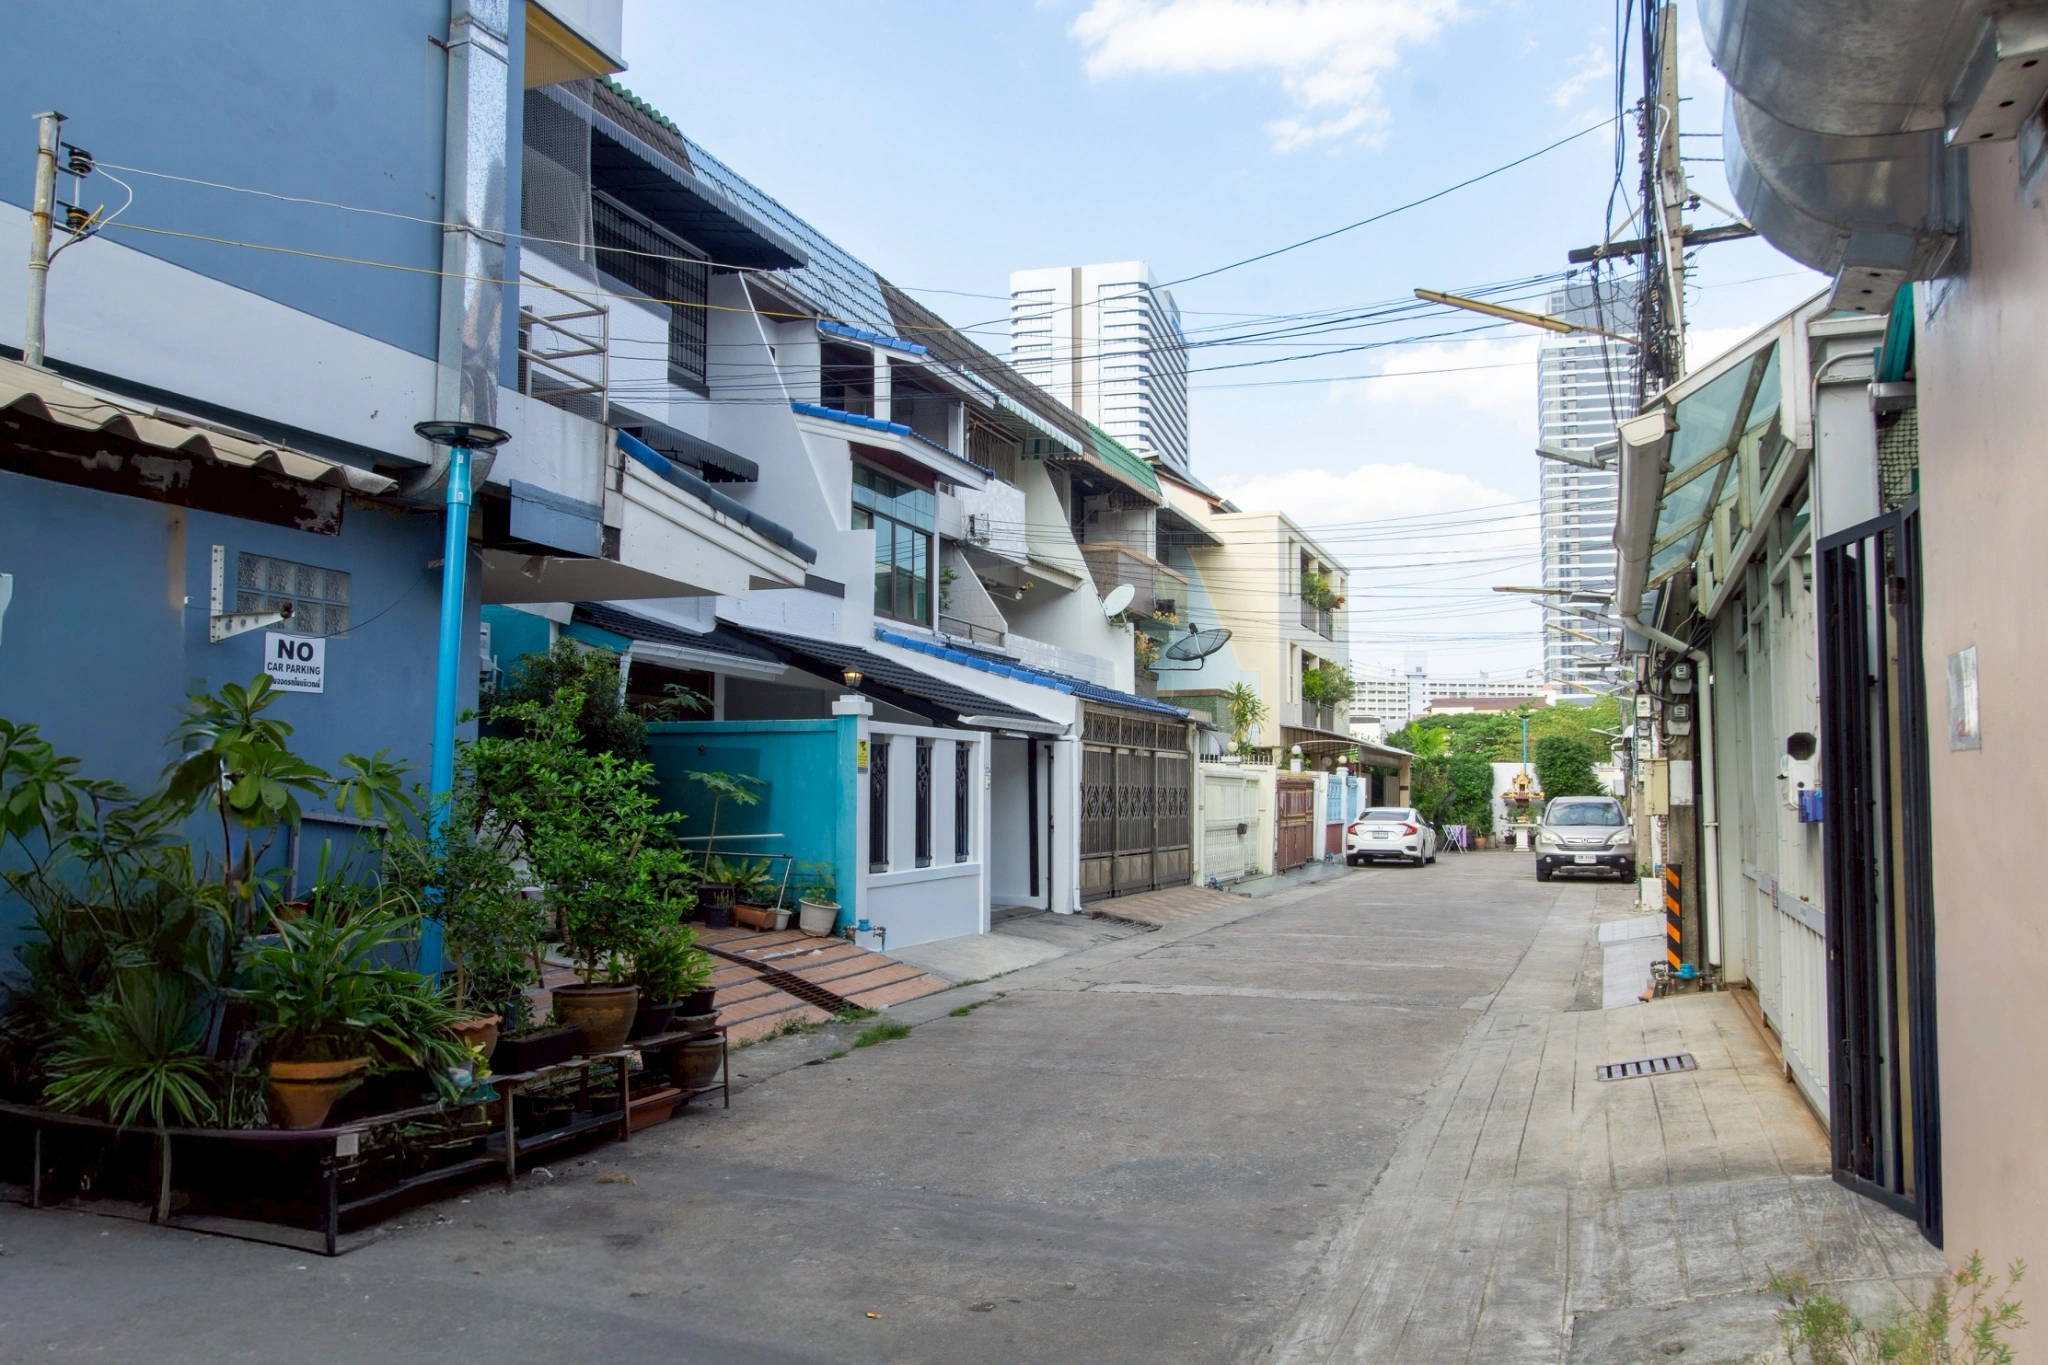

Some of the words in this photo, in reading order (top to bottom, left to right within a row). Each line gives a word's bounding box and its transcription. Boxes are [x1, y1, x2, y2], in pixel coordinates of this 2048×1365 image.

[278, 639, 314, 662] NO
[267, 662, 284, 672] CAR
[285, 664, 321, 675] PARKING
